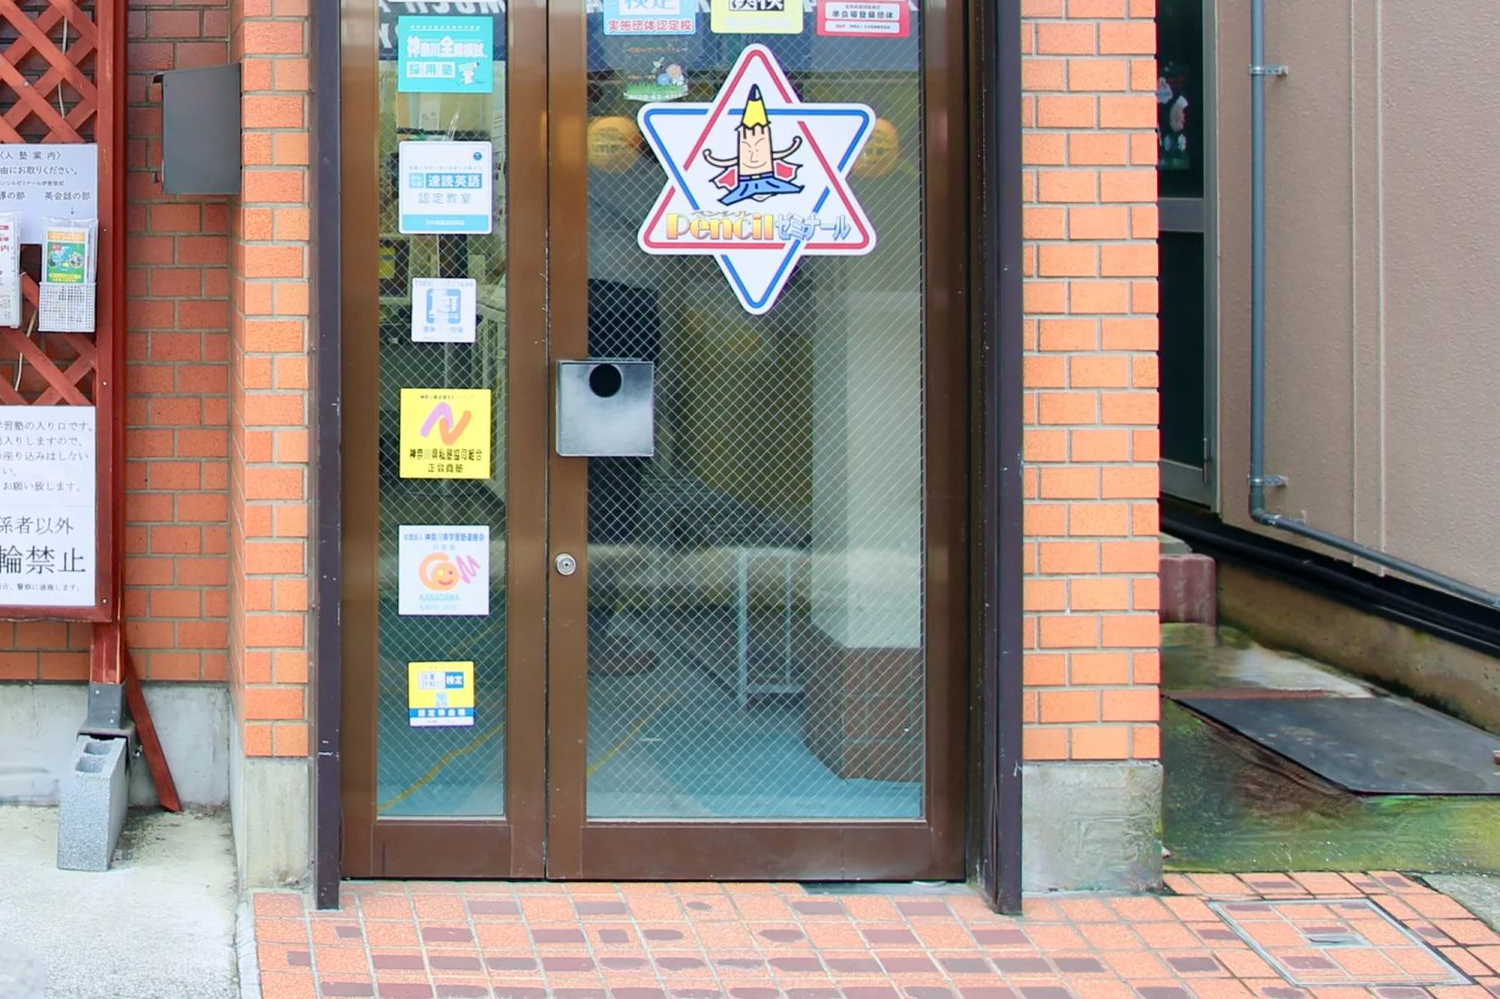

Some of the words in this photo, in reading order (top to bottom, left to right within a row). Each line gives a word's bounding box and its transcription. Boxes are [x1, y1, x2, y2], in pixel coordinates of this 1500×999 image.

[608, 19, 692, 31] 実施団体認定校
[44, 191, 91, 201] 英会話の部
[665, 212, 851, 241] Pencilゼミナール
